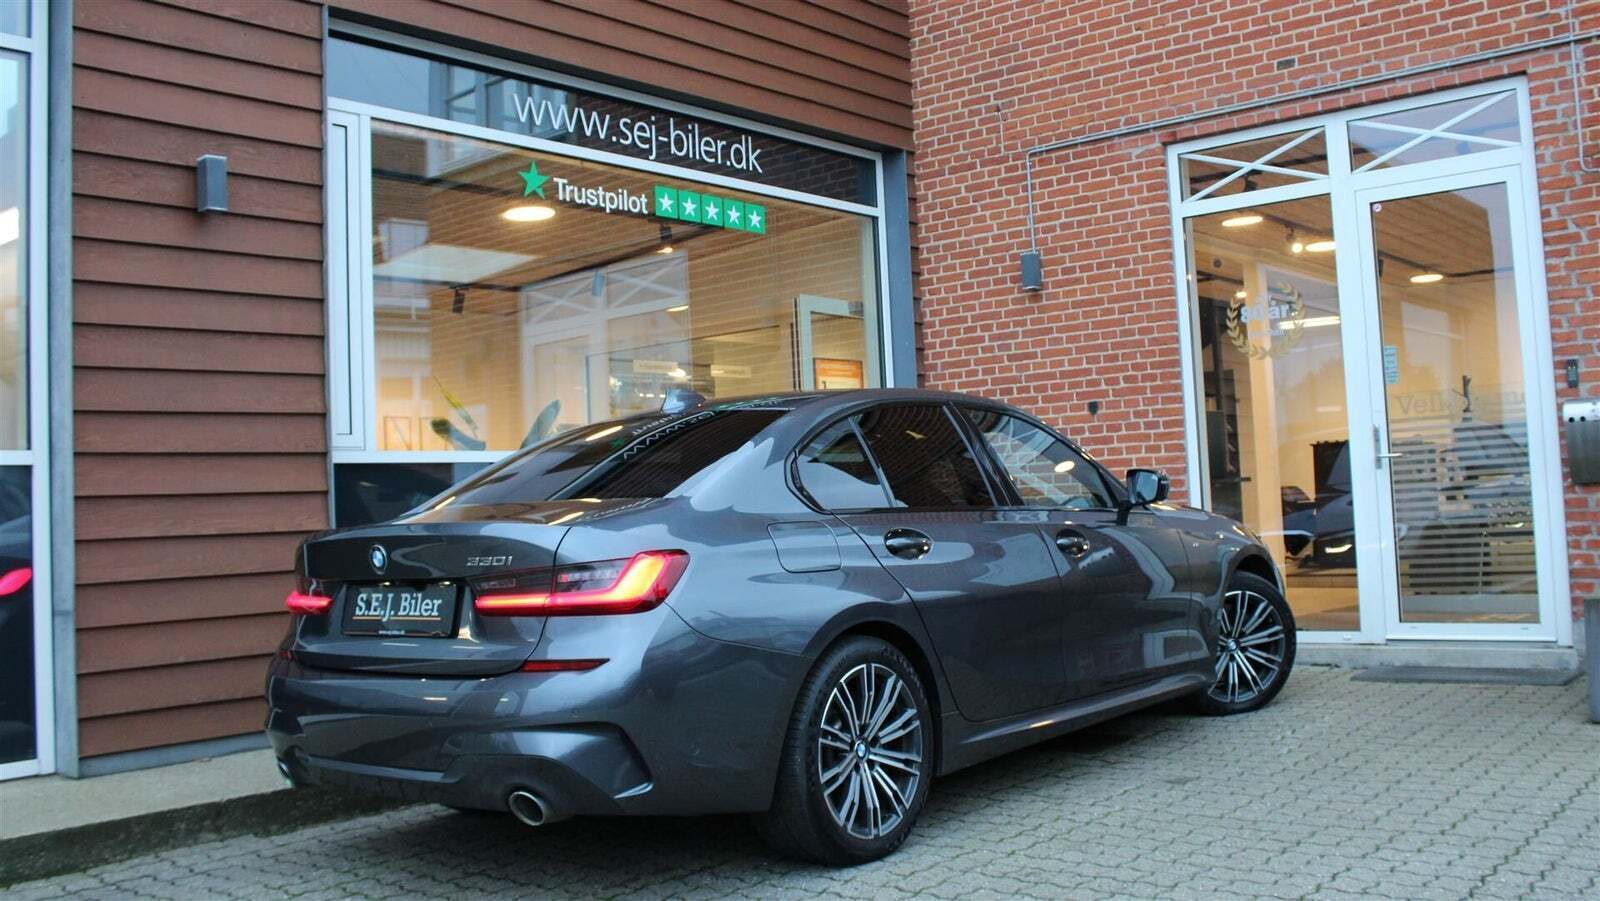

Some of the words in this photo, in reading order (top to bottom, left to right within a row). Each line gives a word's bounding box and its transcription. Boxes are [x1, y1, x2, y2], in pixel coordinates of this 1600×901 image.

[514, 93, 763, 173] www.sej-biler.dk
[552, 176, 649, 215] Trustpilot
[355, 593, 394, 621] S.E.J.
[398, 592, 442, 616] Biler
